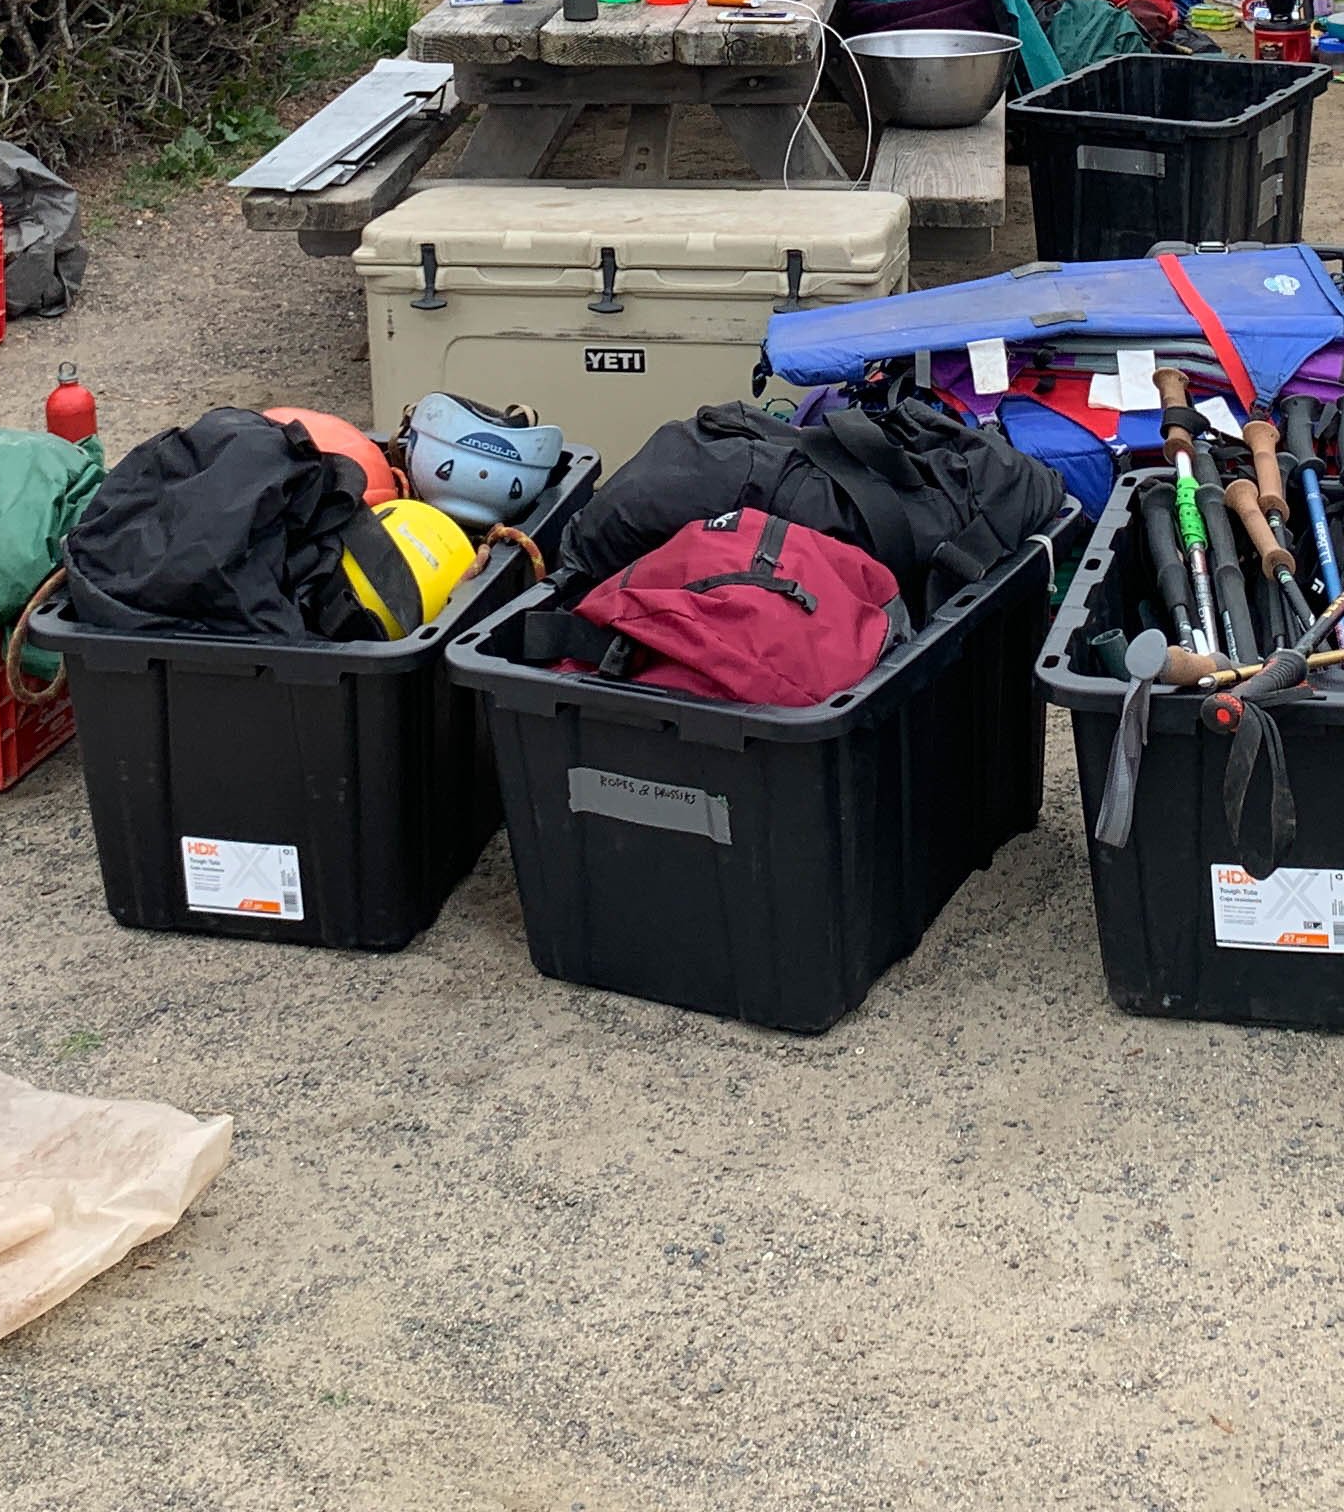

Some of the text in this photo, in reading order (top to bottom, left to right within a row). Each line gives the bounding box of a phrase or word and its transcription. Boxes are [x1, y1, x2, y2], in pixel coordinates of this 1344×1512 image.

[586, 351, 642, 370] YETI
[461, 438, 520, 459] armour
[600, 775, 635, 793] ROPES
[187, 841, 218, 856] HDX
[1217, 870, 1257, 885] HDX
